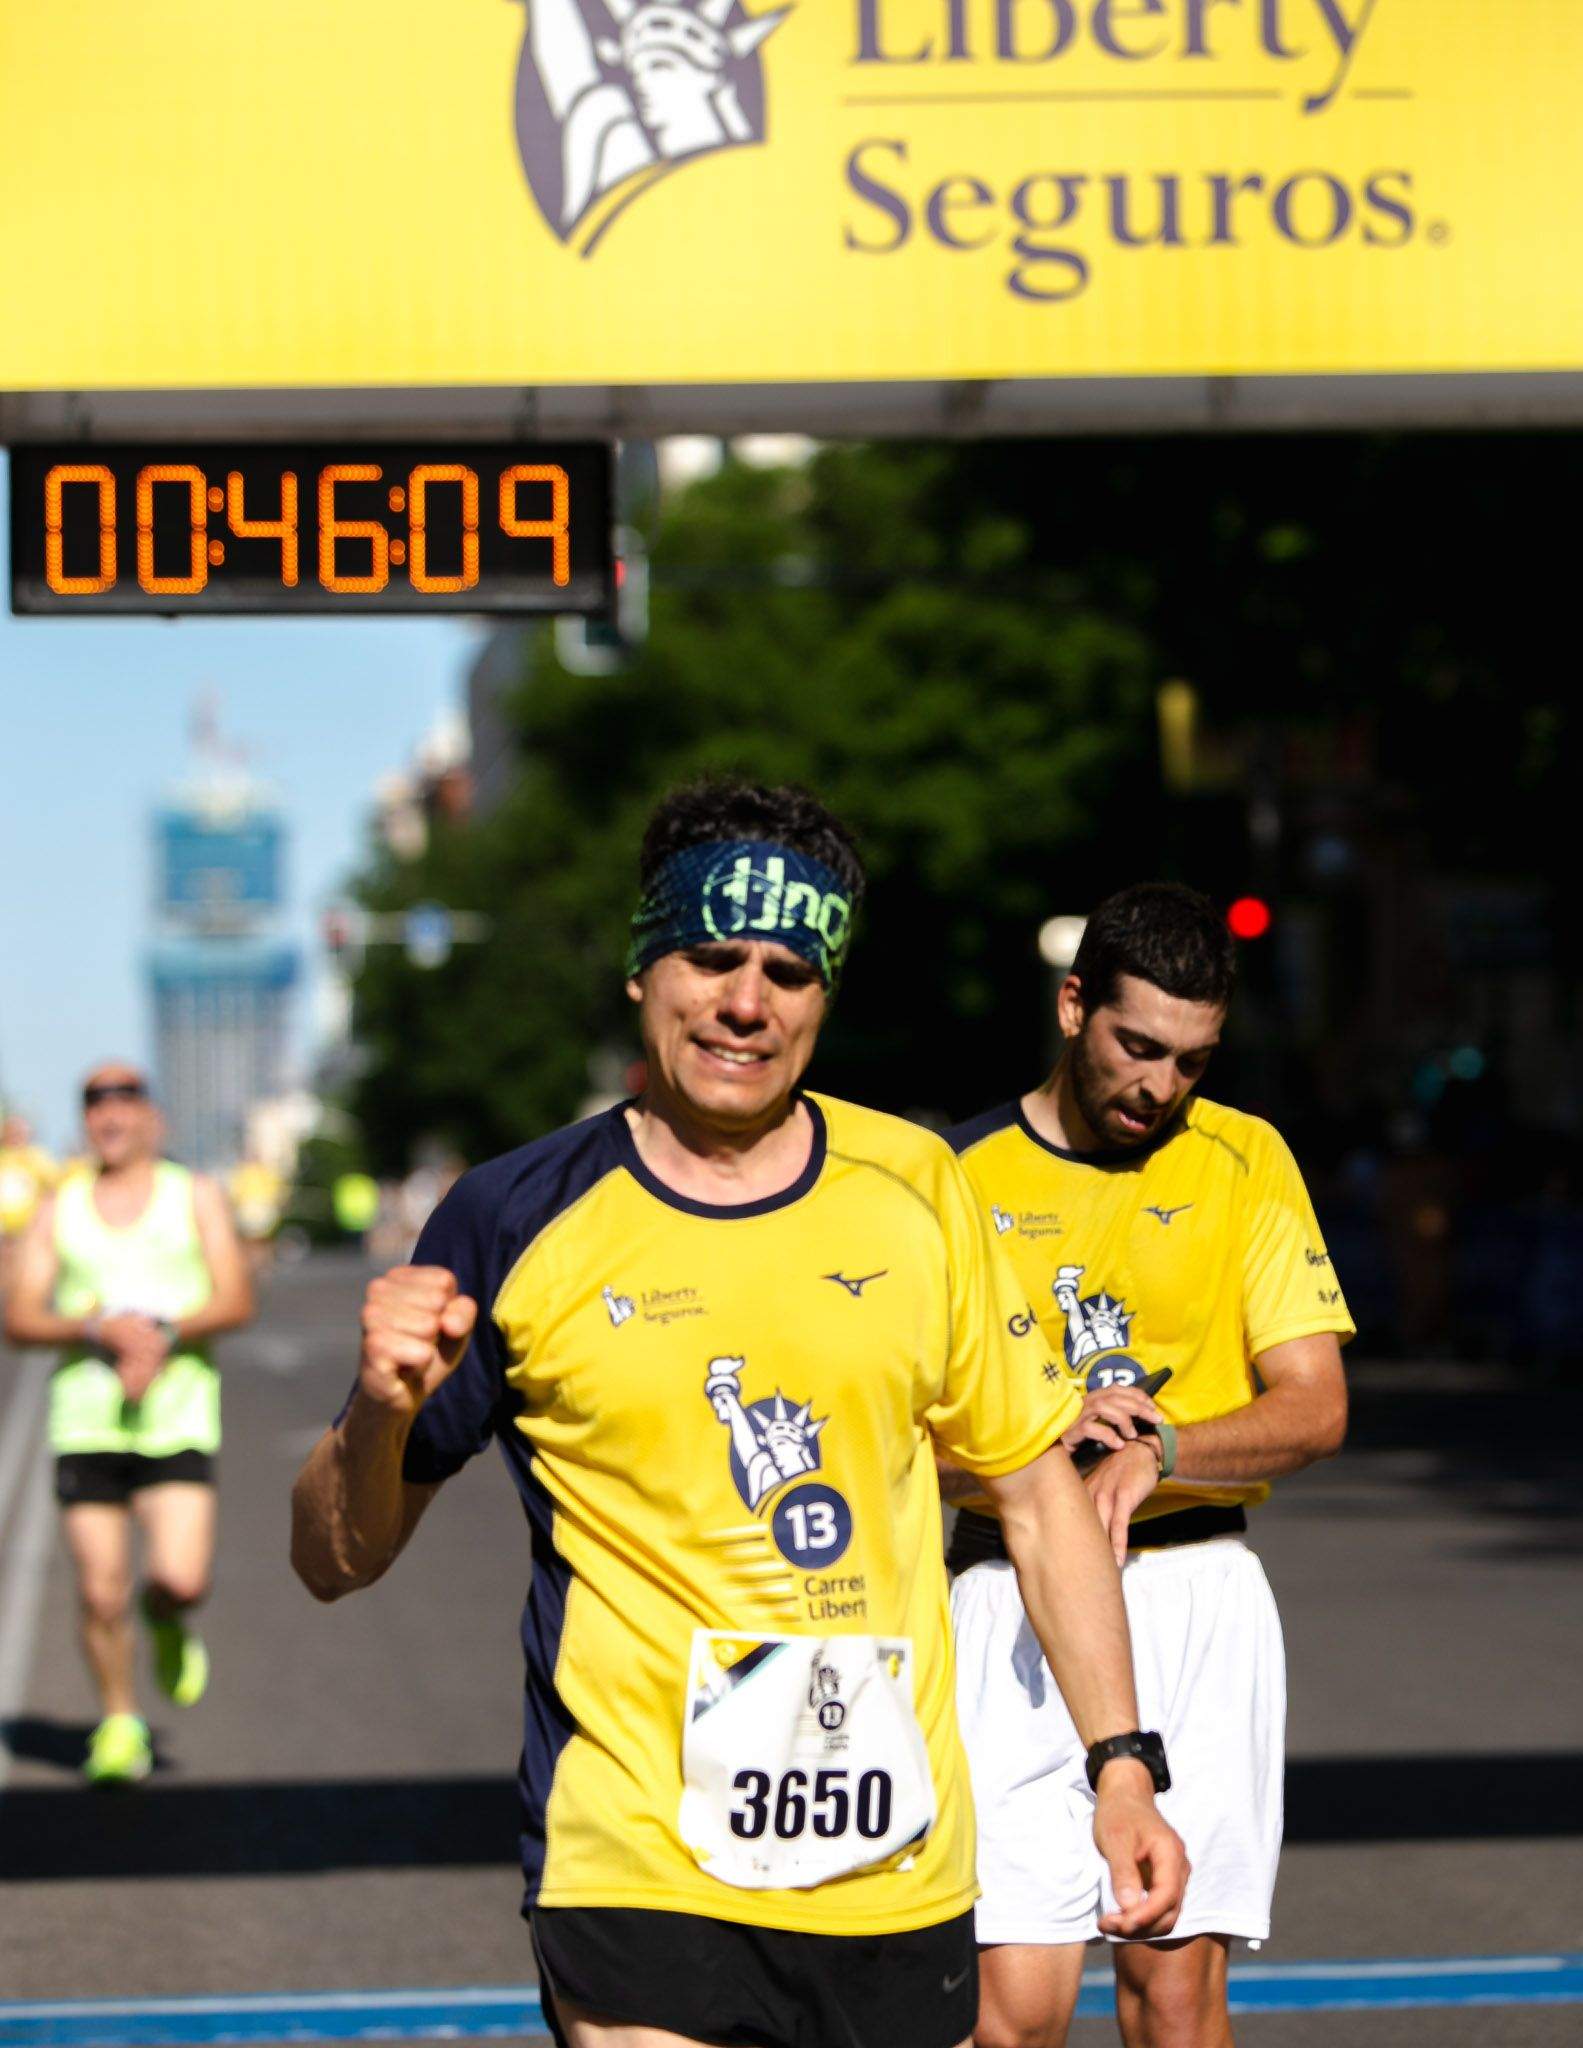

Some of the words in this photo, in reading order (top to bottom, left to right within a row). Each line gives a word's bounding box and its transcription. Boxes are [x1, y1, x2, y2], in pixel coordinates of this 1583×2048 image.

[45, 464, 569, 594] 00:46:09
[784, 1501, 839, 1551] 13
[729, 1769, 893, 1840] 3650
